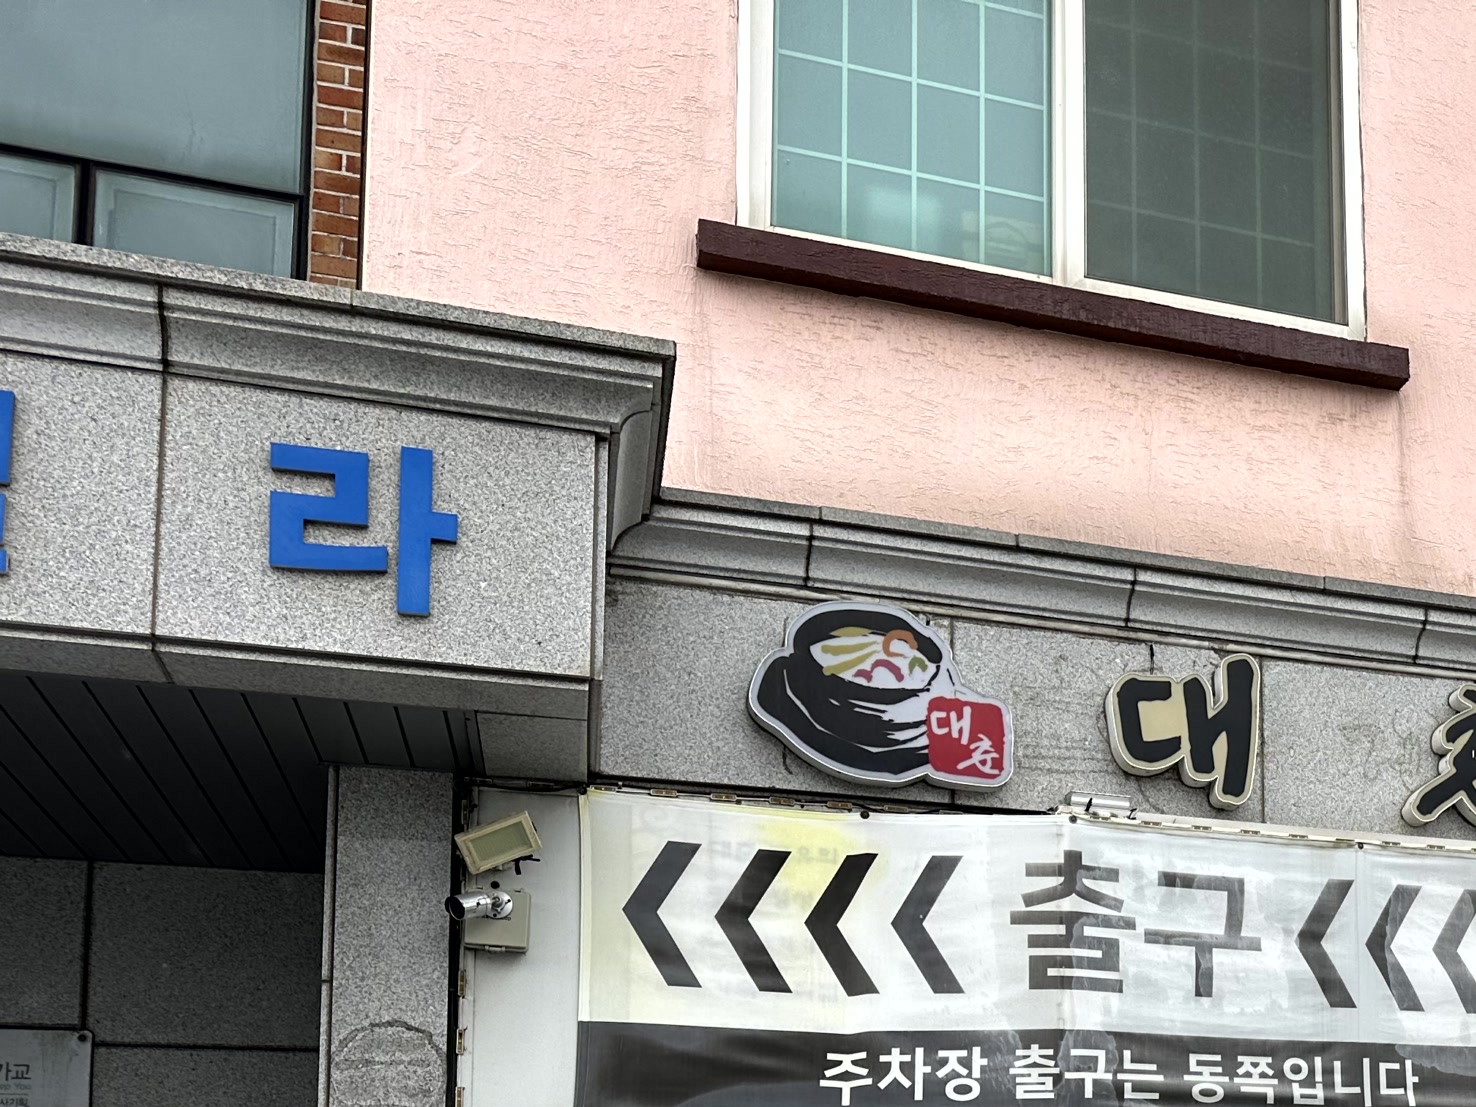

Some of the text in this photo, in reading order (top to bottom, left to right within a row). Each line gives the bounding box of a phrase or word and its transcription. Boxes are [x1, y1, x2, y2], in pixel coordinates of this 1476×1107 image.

[1009, 851, 1263, 997] 출구
[819, 1043, 1419, 1107] 주차장 출구는 동쪽입니다
